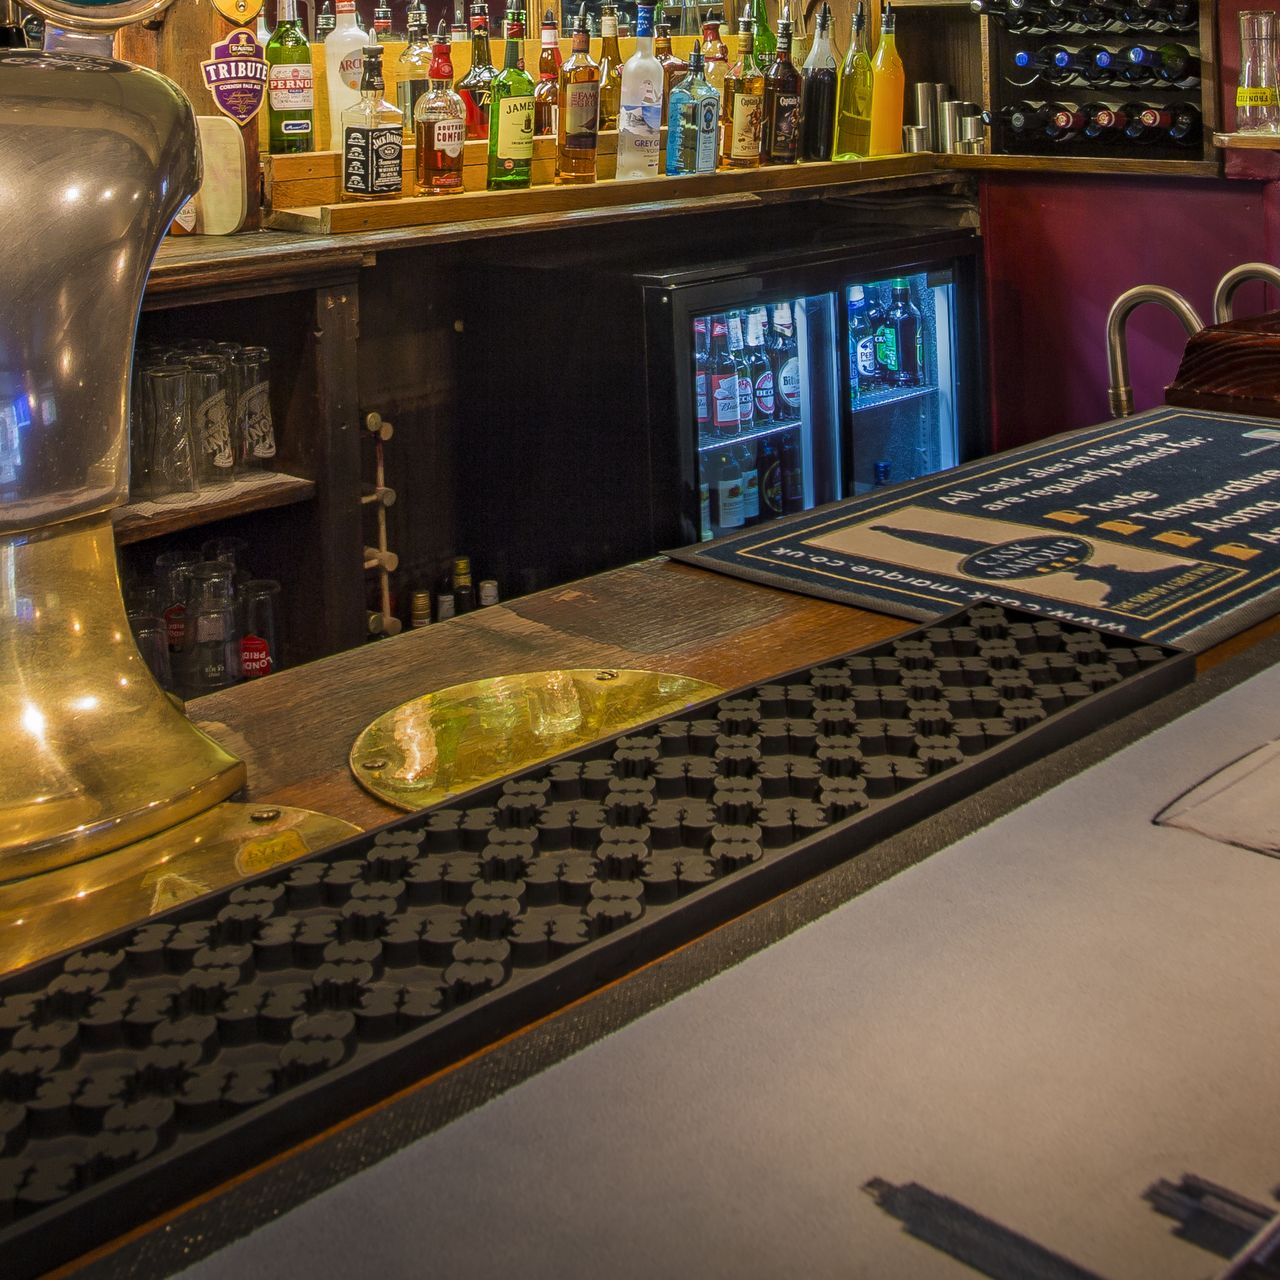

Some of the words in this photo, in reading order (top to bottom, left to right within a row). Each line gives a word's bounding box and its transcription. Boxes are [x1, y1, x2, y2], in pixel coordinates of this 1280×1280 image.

[206, 61, 268, 82] TRIBUTE
[937, 489, 981, 506] All
[979, 475, 1026, 493] cask
[1026, 457, 1073, 480] ales
[1072, 451, 1091, 466] in
[1086, 439, 1133, 463] this
[1128, 432, 1169, 450] pub
[982, 497, 1022, 512] are
[1024, 468, 1120, 499] regularly
[1120, 445, 1177, 467] tested
[1175, 436, 1213, 451] for:
[1077, 490, 1160, 513] Taste
[974, 542, 1037, 568] CASK
[985, 540, 1084, 579] MARQUE
[771, 546, 1127, 634] www.cask-marque.co.uk
